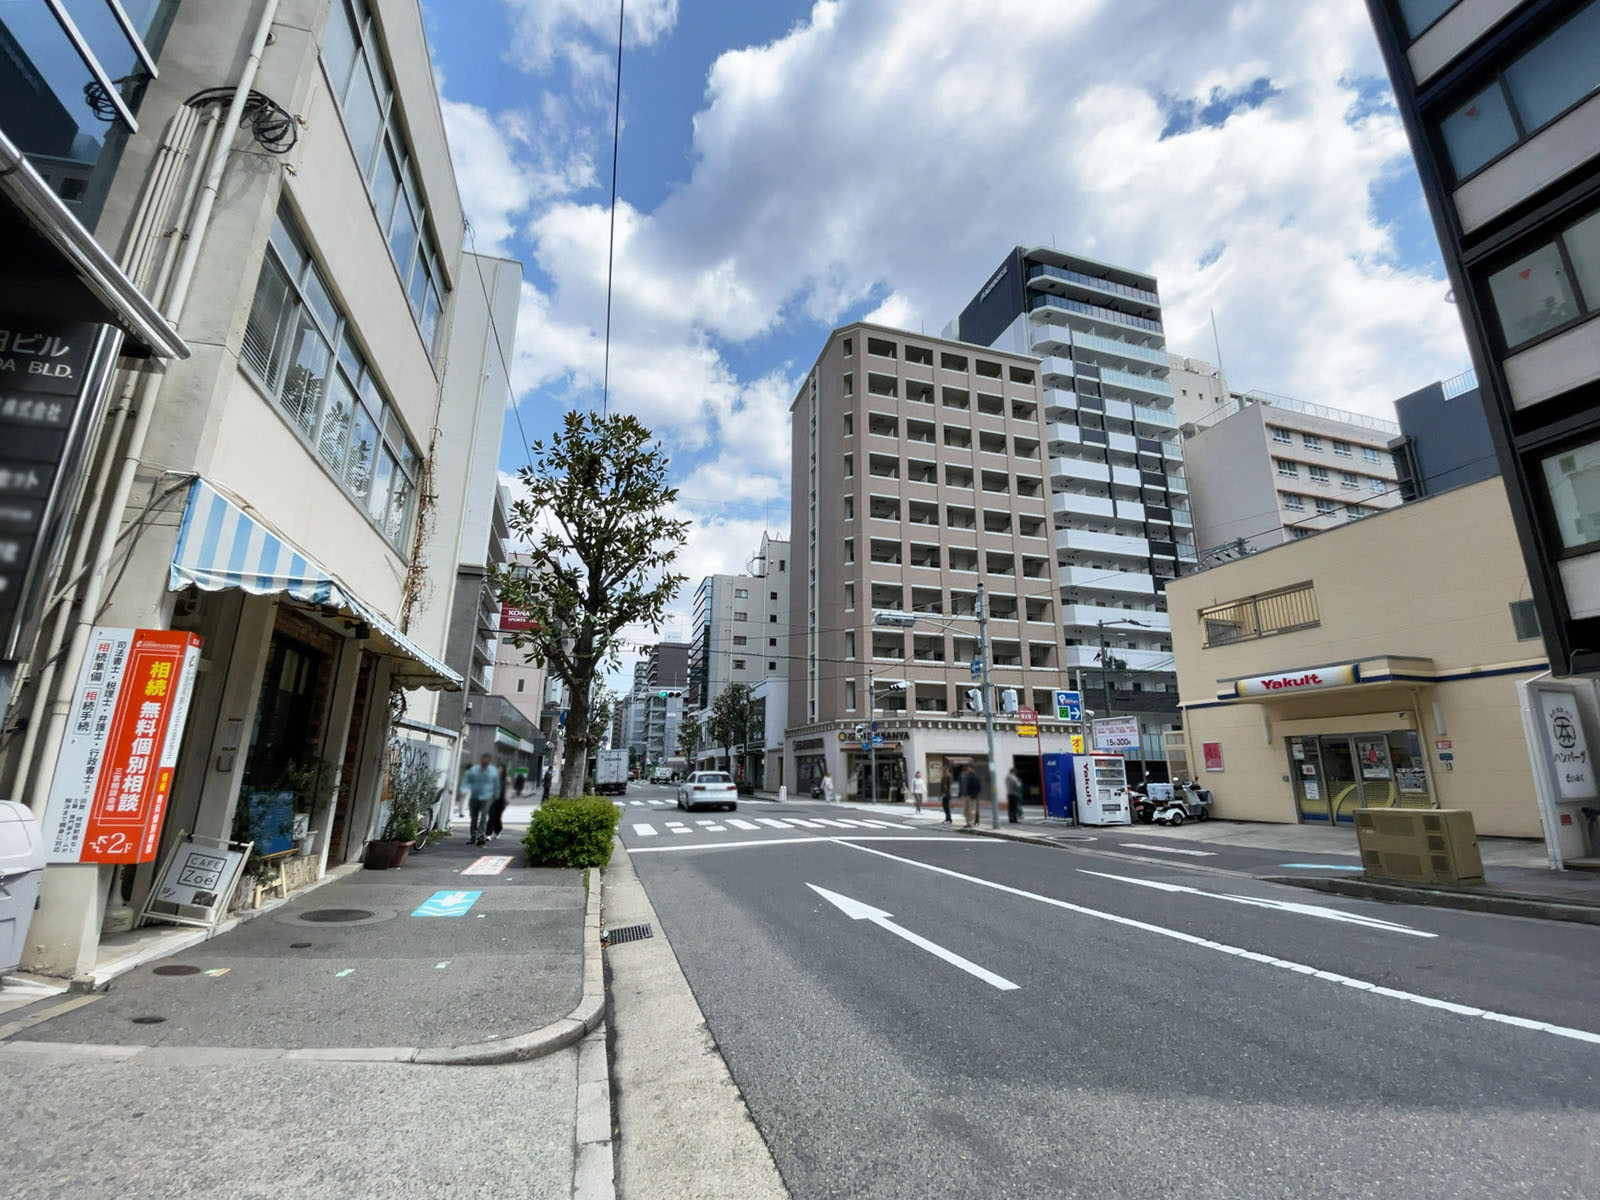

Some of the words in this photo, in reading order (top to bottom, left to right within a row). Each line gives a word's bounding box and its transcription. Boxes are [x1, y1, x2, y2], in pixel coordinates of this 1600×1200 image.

[28, 361, 73, 379] BLD.
[90, 643, 111, 682] 相続準備
[144, 661, 171, 697] 相続
[1261, 673, 1323, 690] Yakult
[77, 691, 98, 732] 相続手続
[117, 701, 161, 812] 無料個別相談
[1083, 762, 1092, 806] Yakult
[107, 832, 133, 854] 2F
[183, 869, 215, 886] Zoé
[191, 857, 221, 870] CAFE
